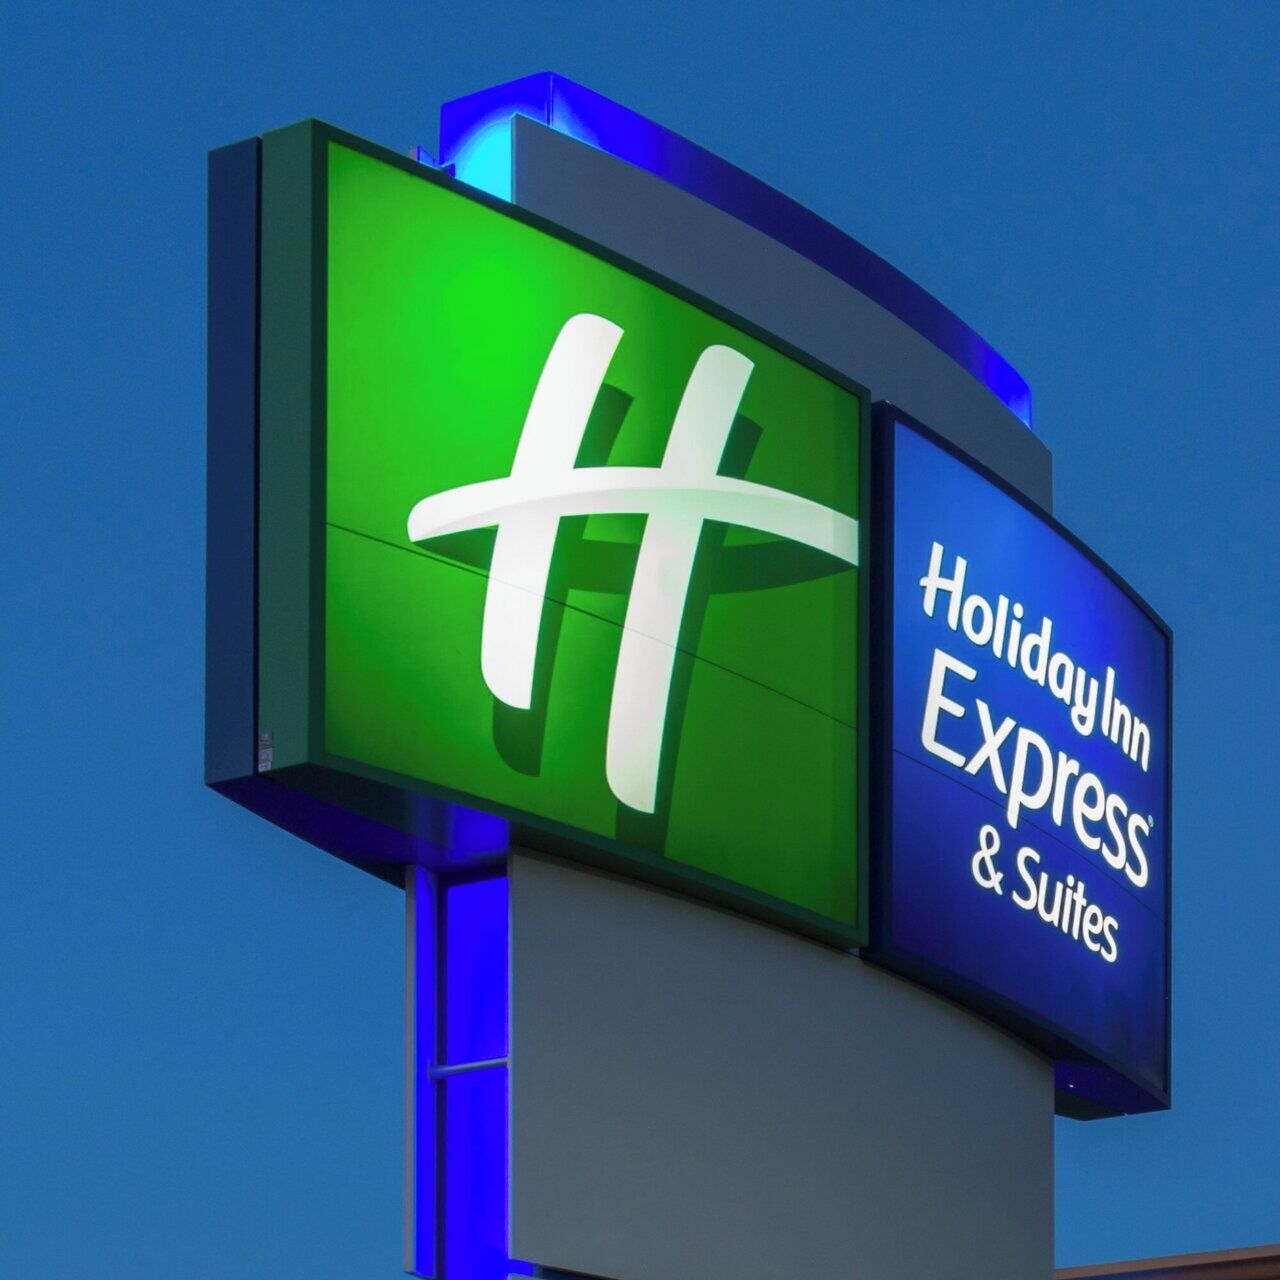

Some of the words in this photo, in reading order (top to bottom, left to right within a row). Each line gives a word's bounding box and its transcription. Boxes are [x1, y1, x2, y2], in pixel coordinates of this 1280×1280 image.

[919, 541, 1099, 736] Holiday
[1101, 666, 1151, 772] Inn
[921, 648, 1150, 888] Express
[971, 824, 1004, 895] &
[1012, 846, 1119, 963] Suites
